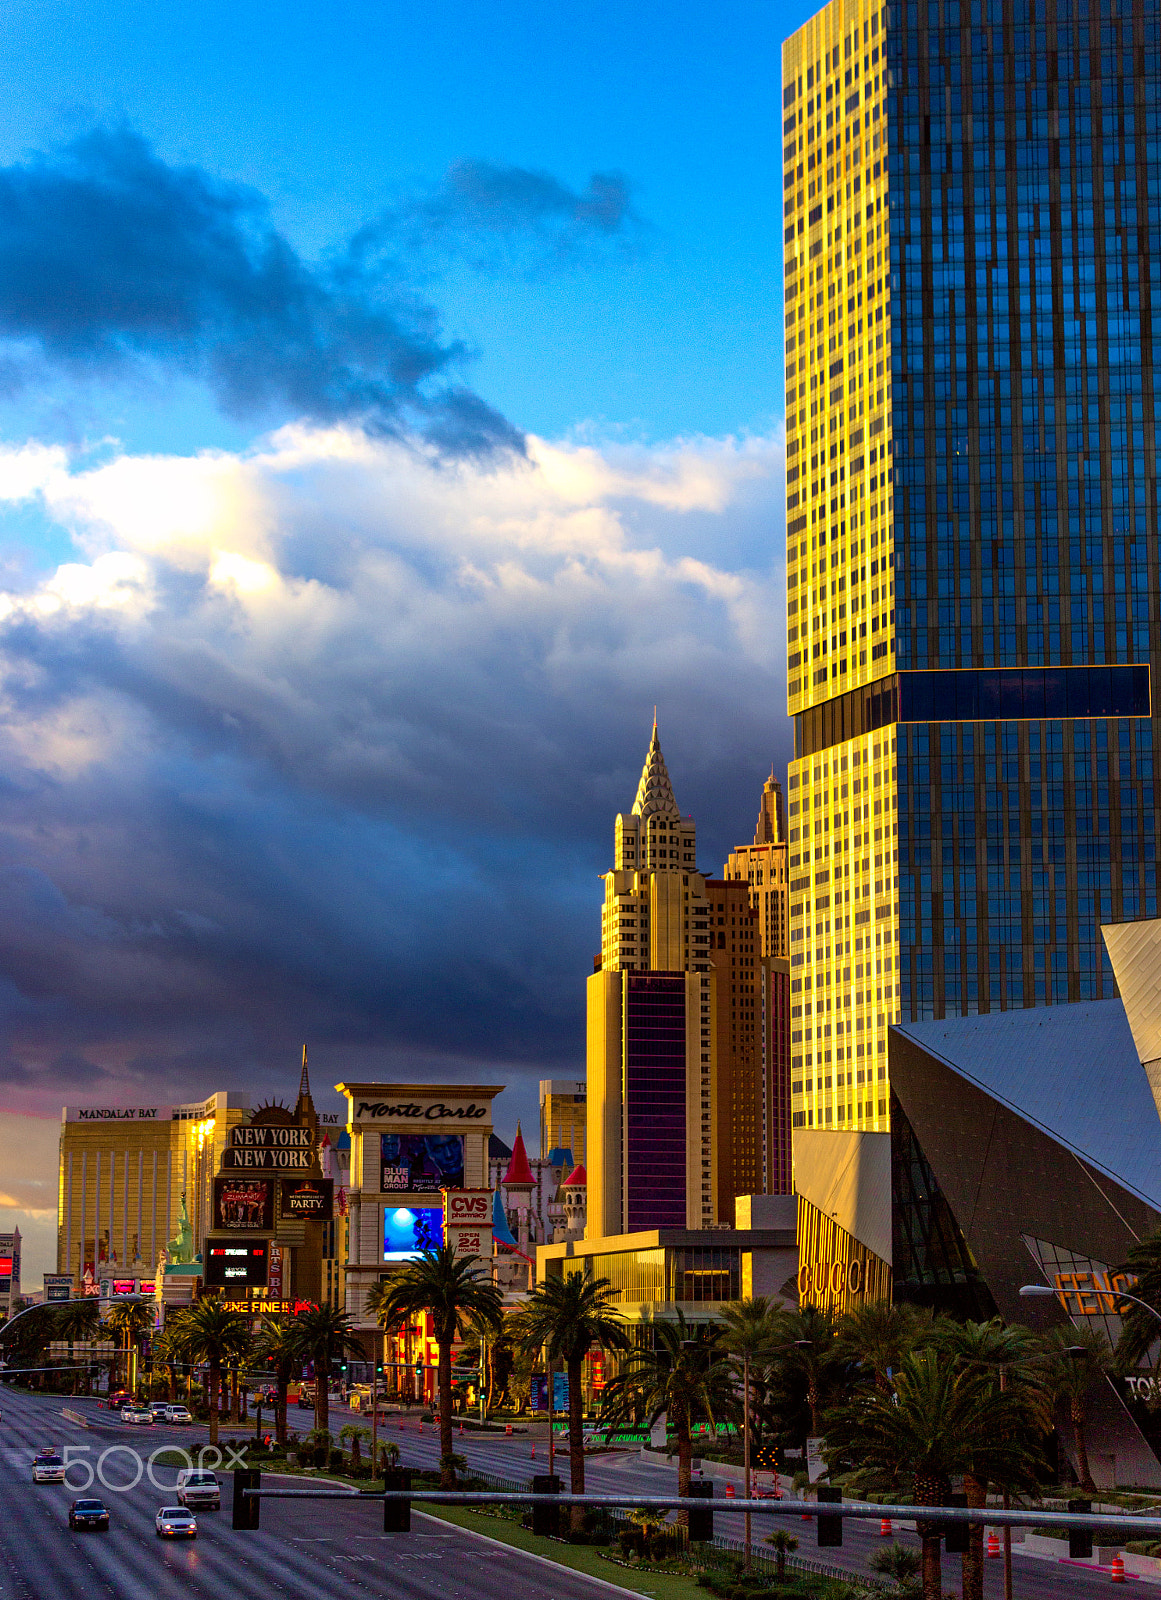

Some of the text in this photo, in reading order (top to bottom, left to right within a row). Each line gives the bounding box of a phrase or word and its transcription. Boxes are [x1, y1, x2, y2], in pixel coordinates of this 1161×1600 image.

[79, 1108, 157, 1119] MANDALAY BAY
[357, 1102, 487, 1120] Monte Carlo
[322, 1113, 339, 1123] BAY
[233, 1128, 309, 1146] NEW YORK
[233, 1150, 309, 1167] NEW YORK
[383, 1167, 409, 1175] BLUE
[383, 1175, 409, 1184] MAN
[290, 1199, 324, 1208] PARTY.
[450, 1197, 488, 1213] CVS
[457, 1237, 481, 1248] 24
[12, 1250, 20, 1283] LUXOR
[798, 1259, 870, 1296] GUCCI
[252, 1301, 280, 1313] FINE
